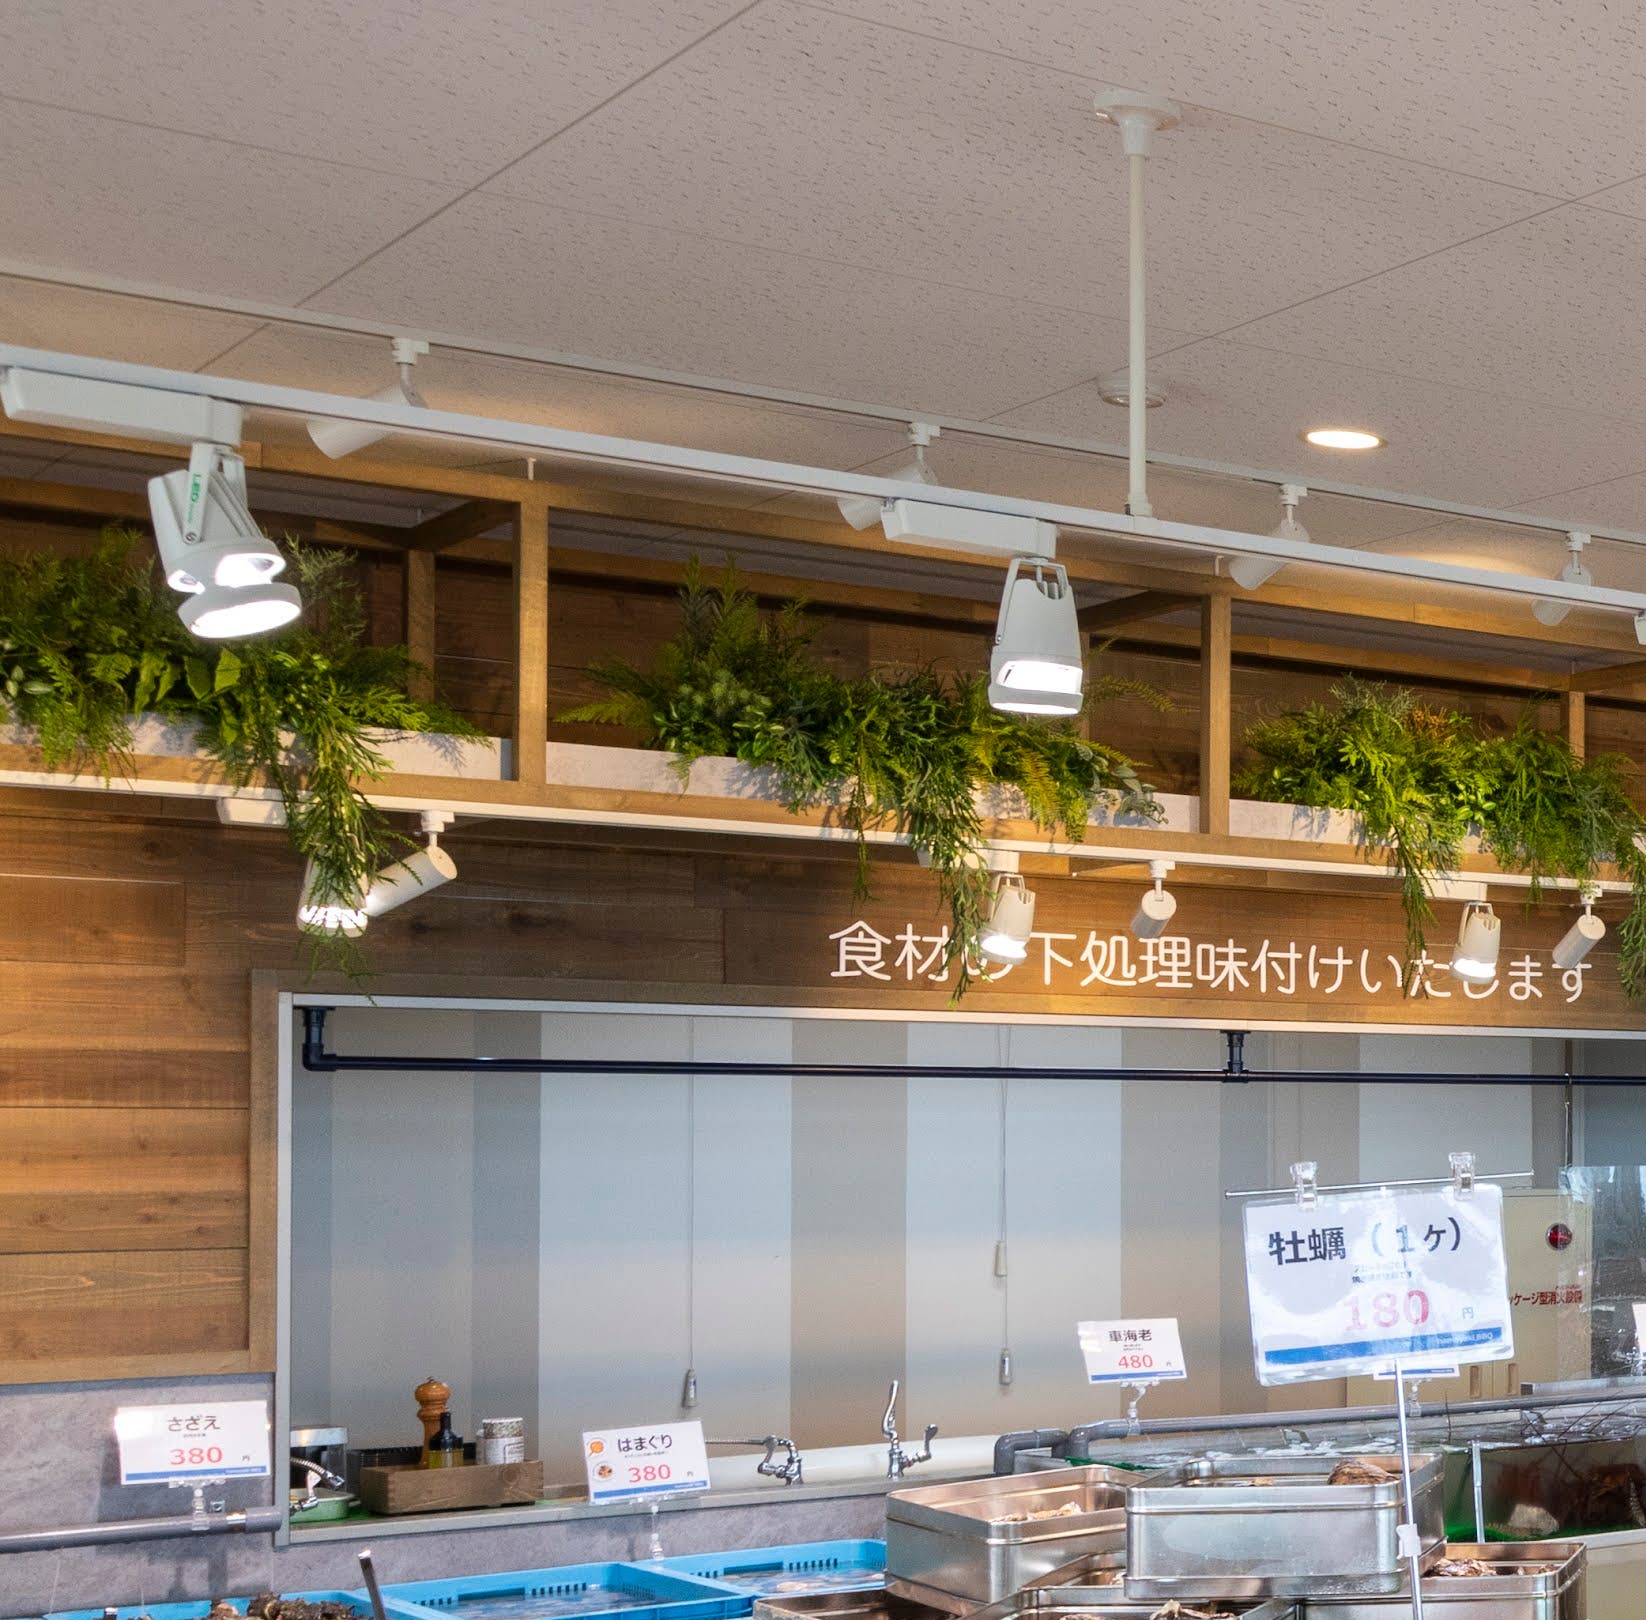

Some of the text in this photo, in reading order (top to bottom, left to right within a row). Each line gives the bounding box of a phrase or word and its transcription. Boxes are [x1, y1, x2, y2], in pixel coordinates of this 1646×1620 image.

[1345, 1289, 1430, 1331] 180
[1118, 1353, 1153, 1369] 480
[167, 1415, 221, 1432] さざえ
[617, 1433, 673, 1452] はまぐり
[169, 1446, 223, 1466] 380
[628, 1463, 671, 1484] 380
